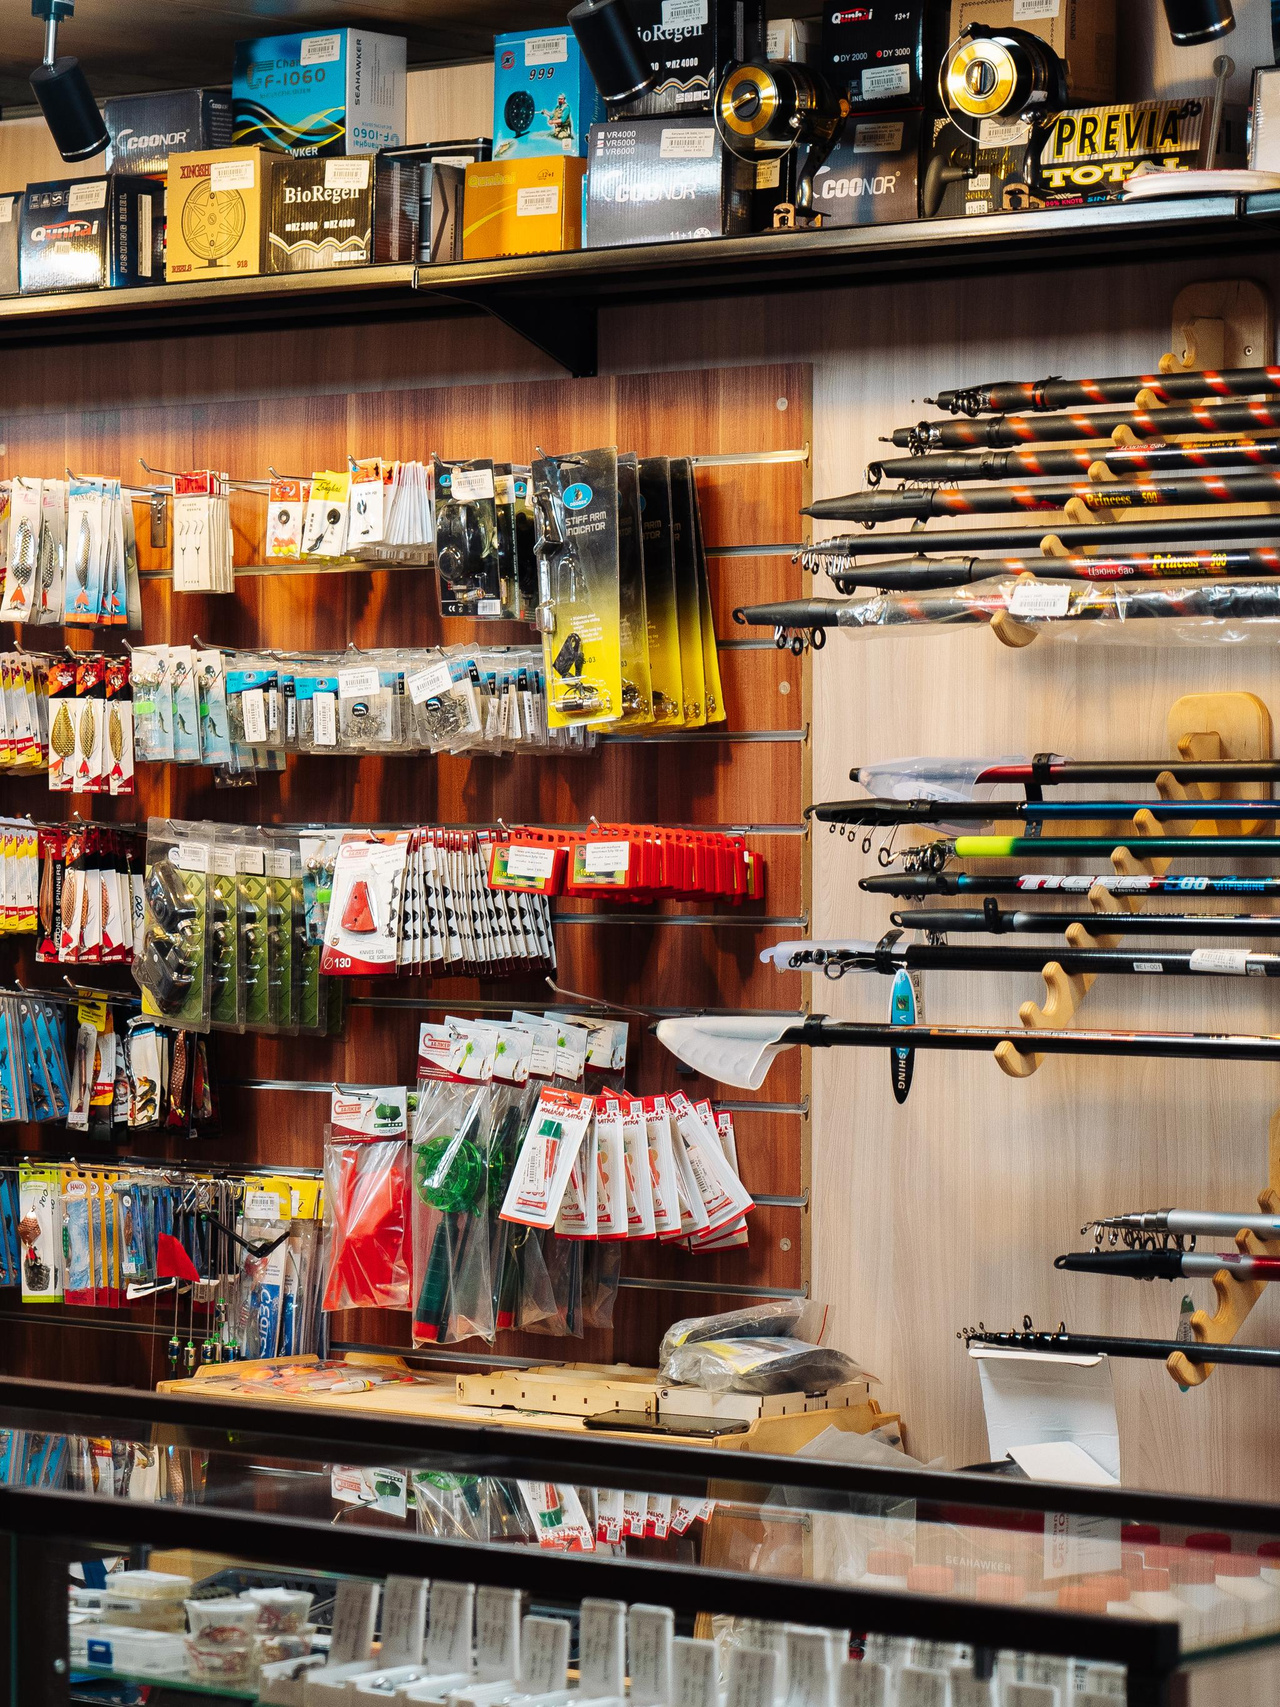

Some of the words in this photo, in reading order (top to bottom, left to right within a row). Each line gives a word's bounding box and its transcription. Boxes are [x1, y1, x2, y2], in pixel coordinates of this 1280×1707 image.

[637, 24, 704, 43] ioRegen
[840, 54, 851, 62] DY
[851, 52, 868, 61] 2000
[883, 49, 894, 58] DY
[894, 47, 910, 56] 3000
[681, 57, 699, 67] 4000
[264, 68, 326, 89] F-1060
[529, 67, 555, 81] 999
[606, 130, 636, 139] VR4000
[1053, 107, 1181, 159] PREVIA
[127, 131, 187, 150] COONOR
[606, 138, 636, 147] VR5000
[605, 146, 635, 156] VR6000
[821, 174, 896, 199] COONOR
[283, 185, 360, 205] BioRegen
[30, 219, 99, 242] Qunhai
[301, 221, 318, 232] 3000
[237, 260, 248, 268] 918
[1085, 492, 1132, 507] Princess
[1141, 492, 1158, 504] 500
[565, 513, 589, 527] STIFF
[589, 511, 607, 521] ARM
[1152, 554, 1199, 569] Princess
[1210, 553, 1227, 567] 500
[1088, 567, 1117, 577] Цзюнь
[1118, 566, 1134, 576] бао
[1019, 874, 1153, 890] TIGER
[334, 957, 351, 968] 130
[565, 1112, 584, 1122] ЛАТКА
[945, 1555, 1011, 1573] SEAHAWKER
